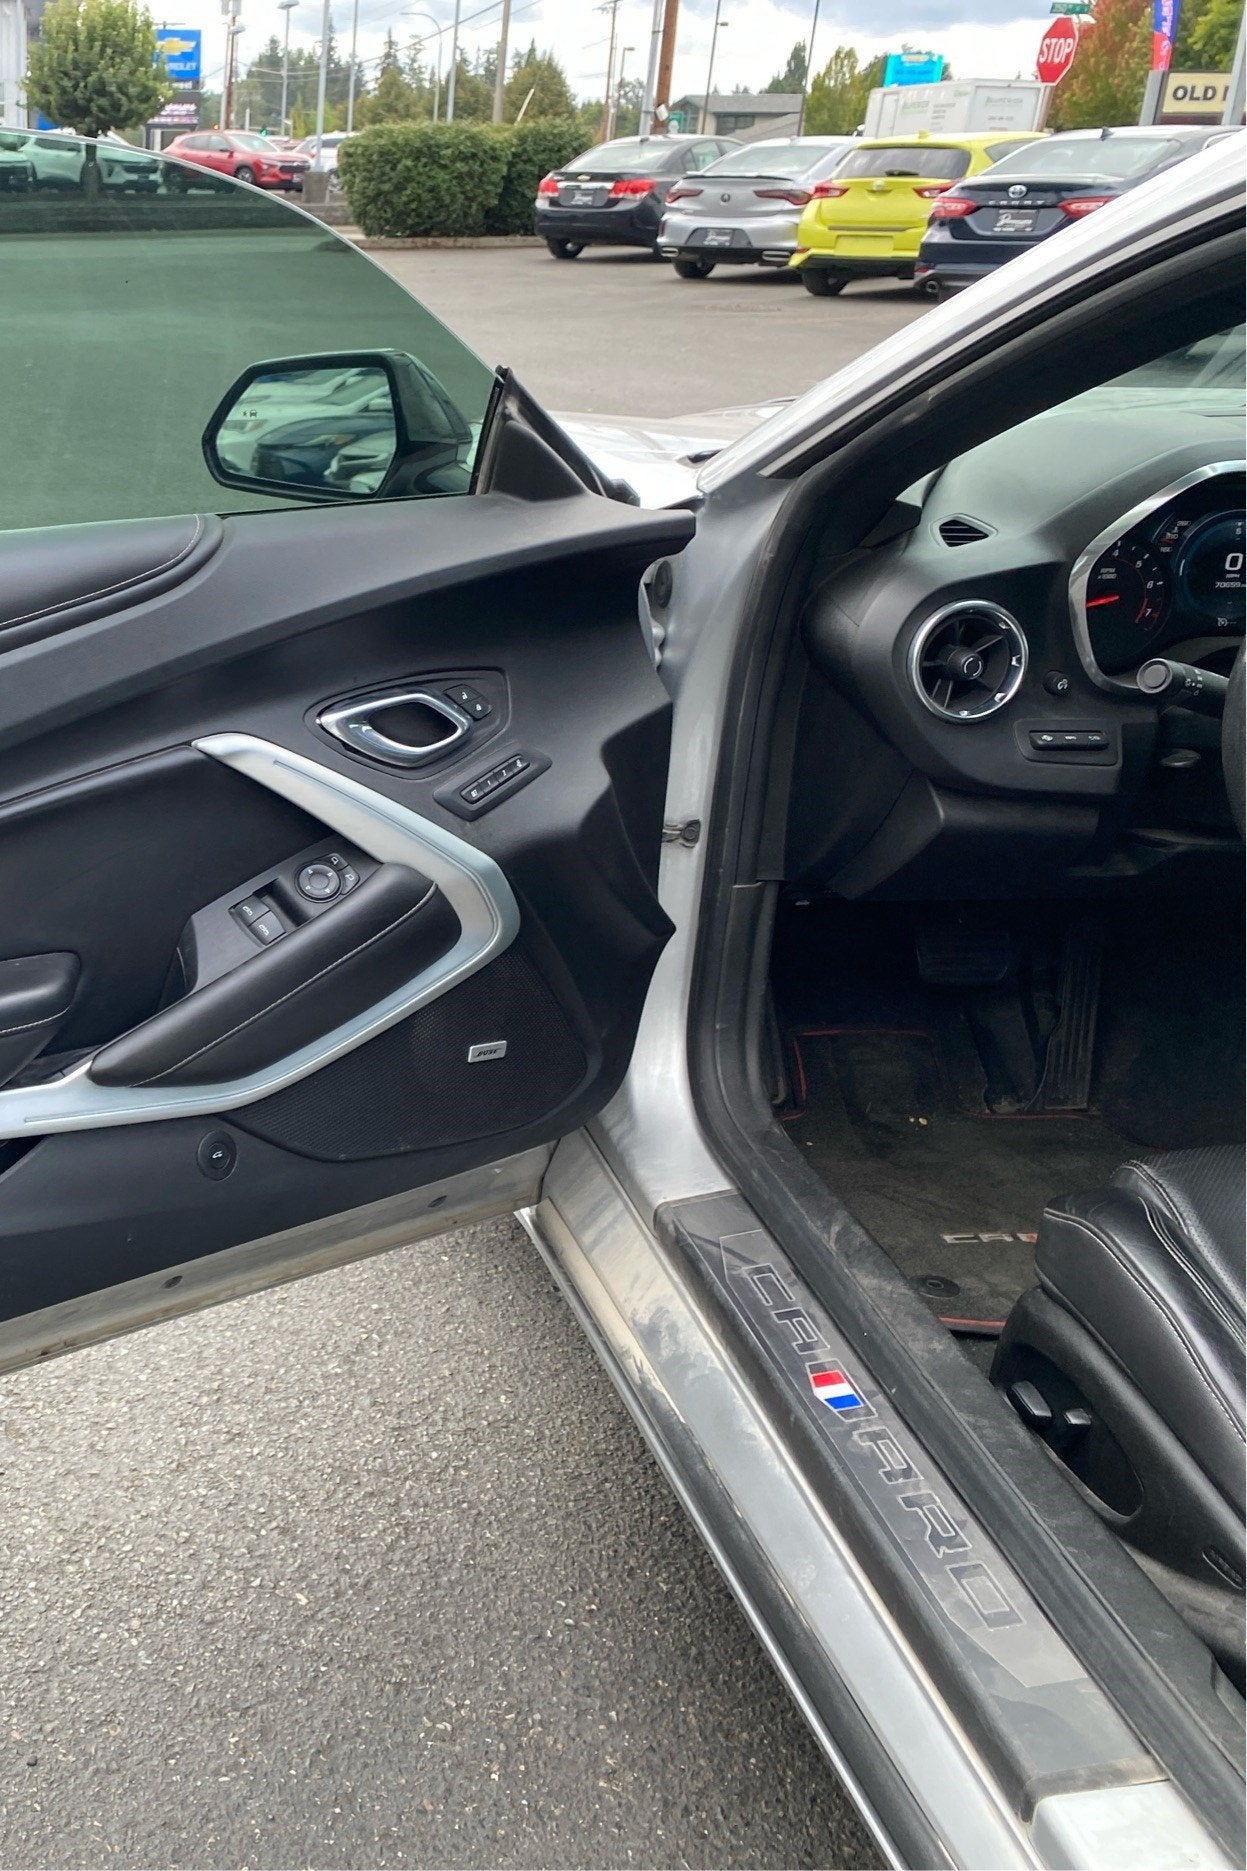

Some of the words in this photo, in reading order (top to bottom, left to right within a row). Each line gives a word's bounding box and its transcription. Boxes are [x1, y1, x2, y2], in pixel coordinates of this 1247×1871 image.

[1039, 38, 1074, 64] STOP
[1172, 85, 1217, 101] OLD
[1224, 552, 1244, 571] 0
[1147, 581, 1154, 589] 6
[1145, 609, 1152, 617] 7
